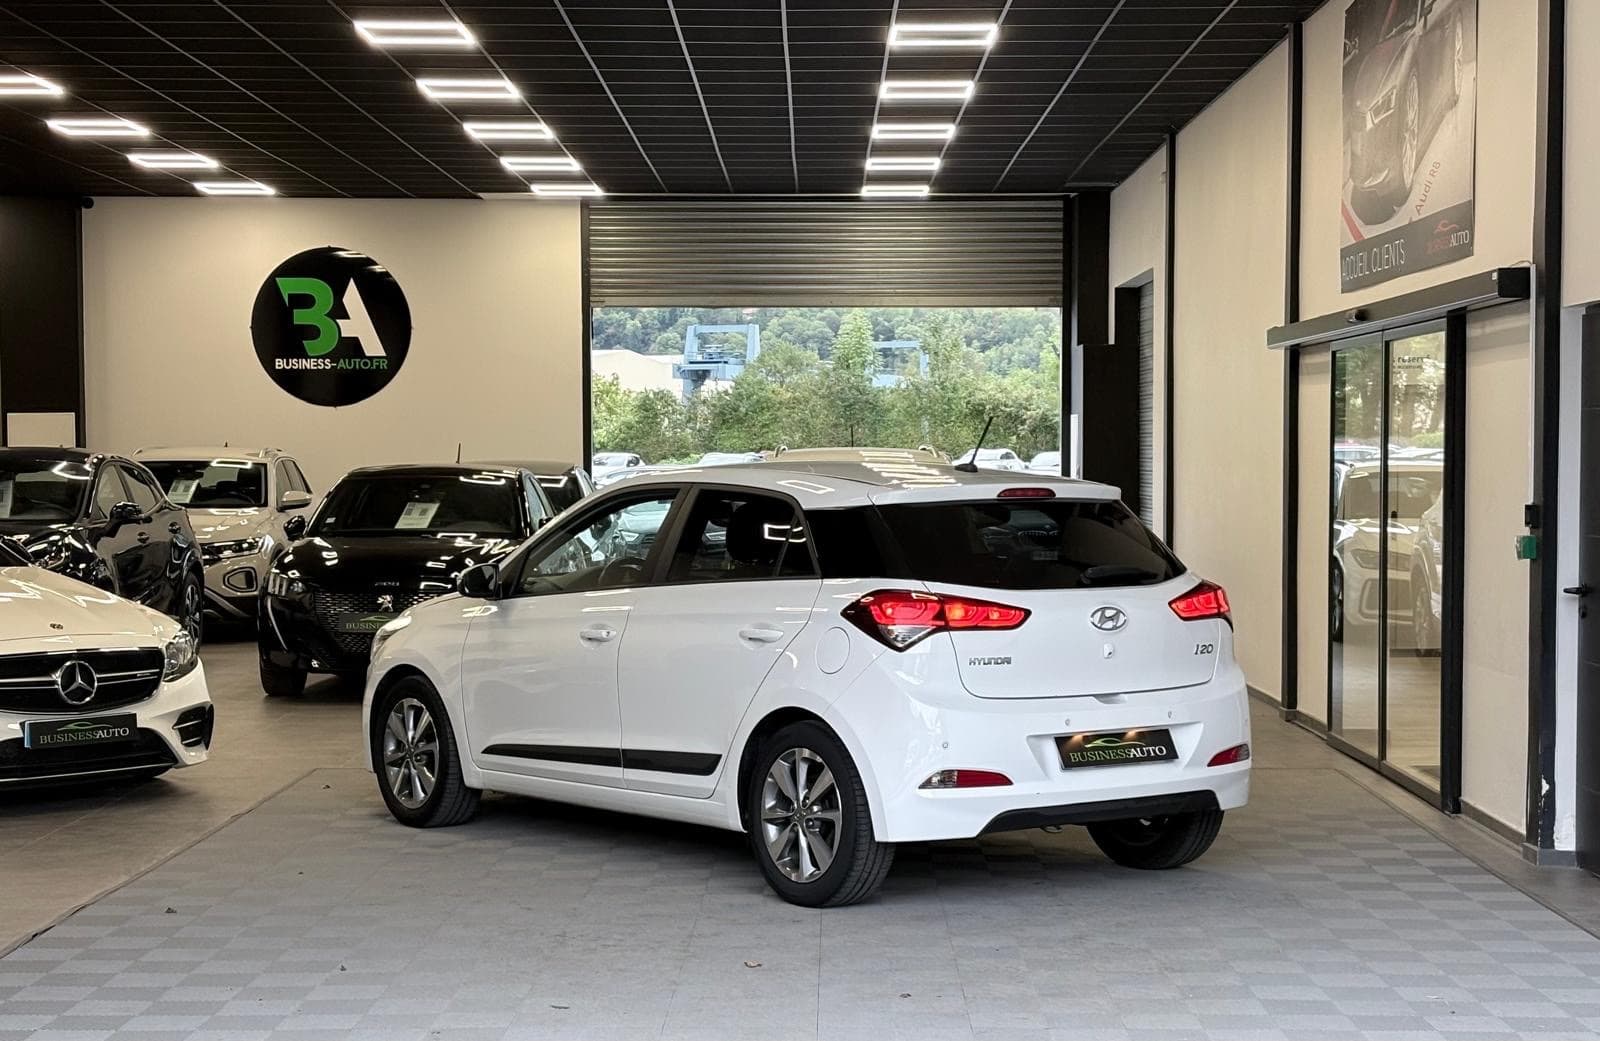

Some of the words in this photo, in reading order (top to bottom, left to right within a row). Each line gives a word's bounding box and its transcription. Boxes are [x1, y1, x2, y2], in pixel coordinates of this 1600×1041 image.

[1415, 180, 1433, 216] Audi
[1371, 238, 1406, 273] CLIENTS
[274, 358, 388, 370] BUSINESS-AUTO.FR
[968, 656, 1012, 666] HYUNDAI
